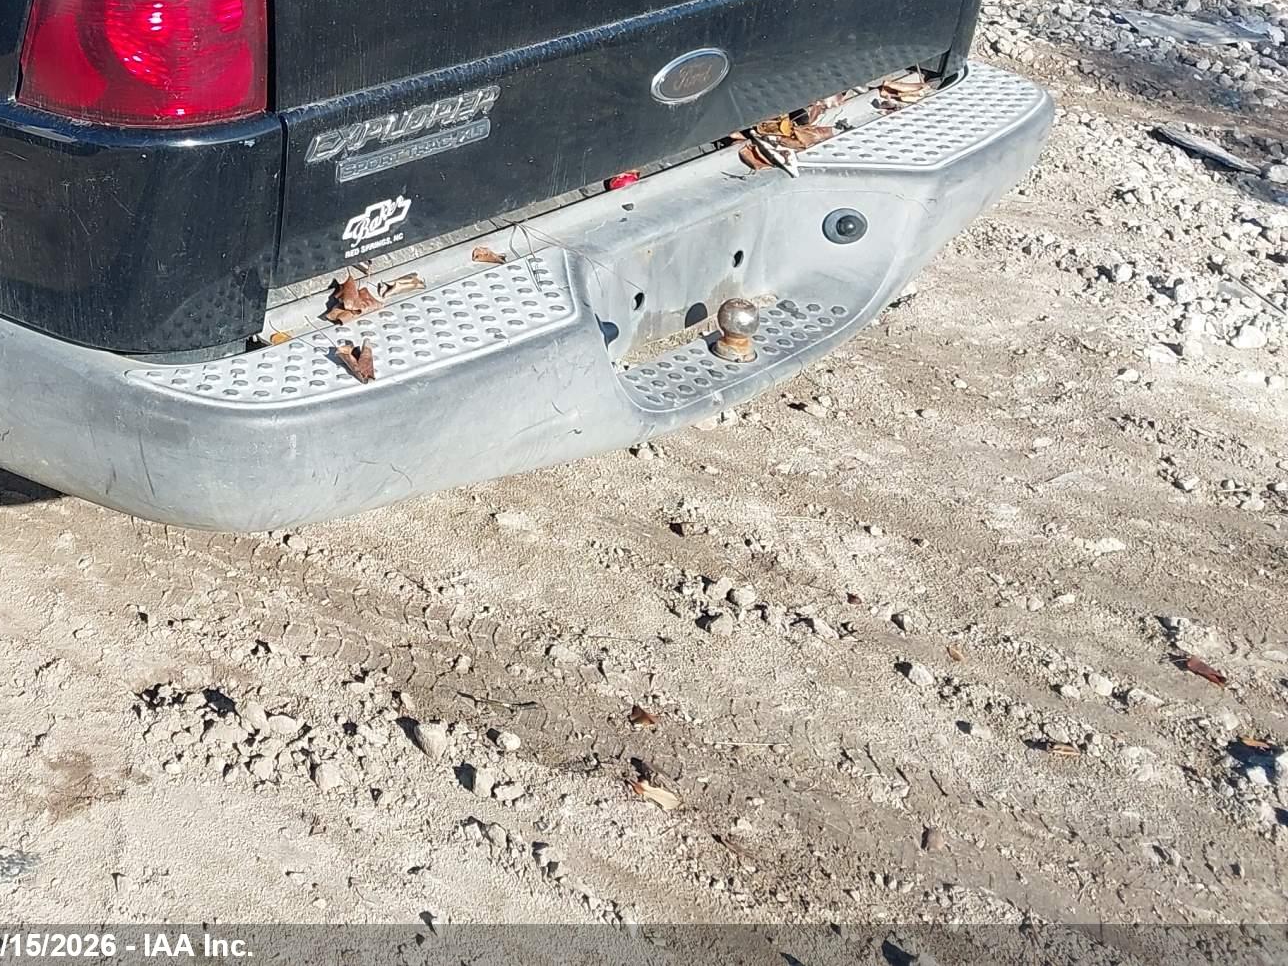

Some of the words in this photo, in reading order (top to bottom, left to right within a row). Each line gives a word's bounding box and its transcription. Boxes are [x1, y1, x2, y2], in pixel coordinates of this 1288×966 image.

[673, 63, 713, 91] Ford
[305, 85, 501, 163] EXPLORER
[342, 151, 402, 179] SPORT
[408, 136, 455, 160] TRAC
[350, 195, 404, 248] Baker
[344, 248, 360, 259] RED
[393, 233, 404, 242] NC
